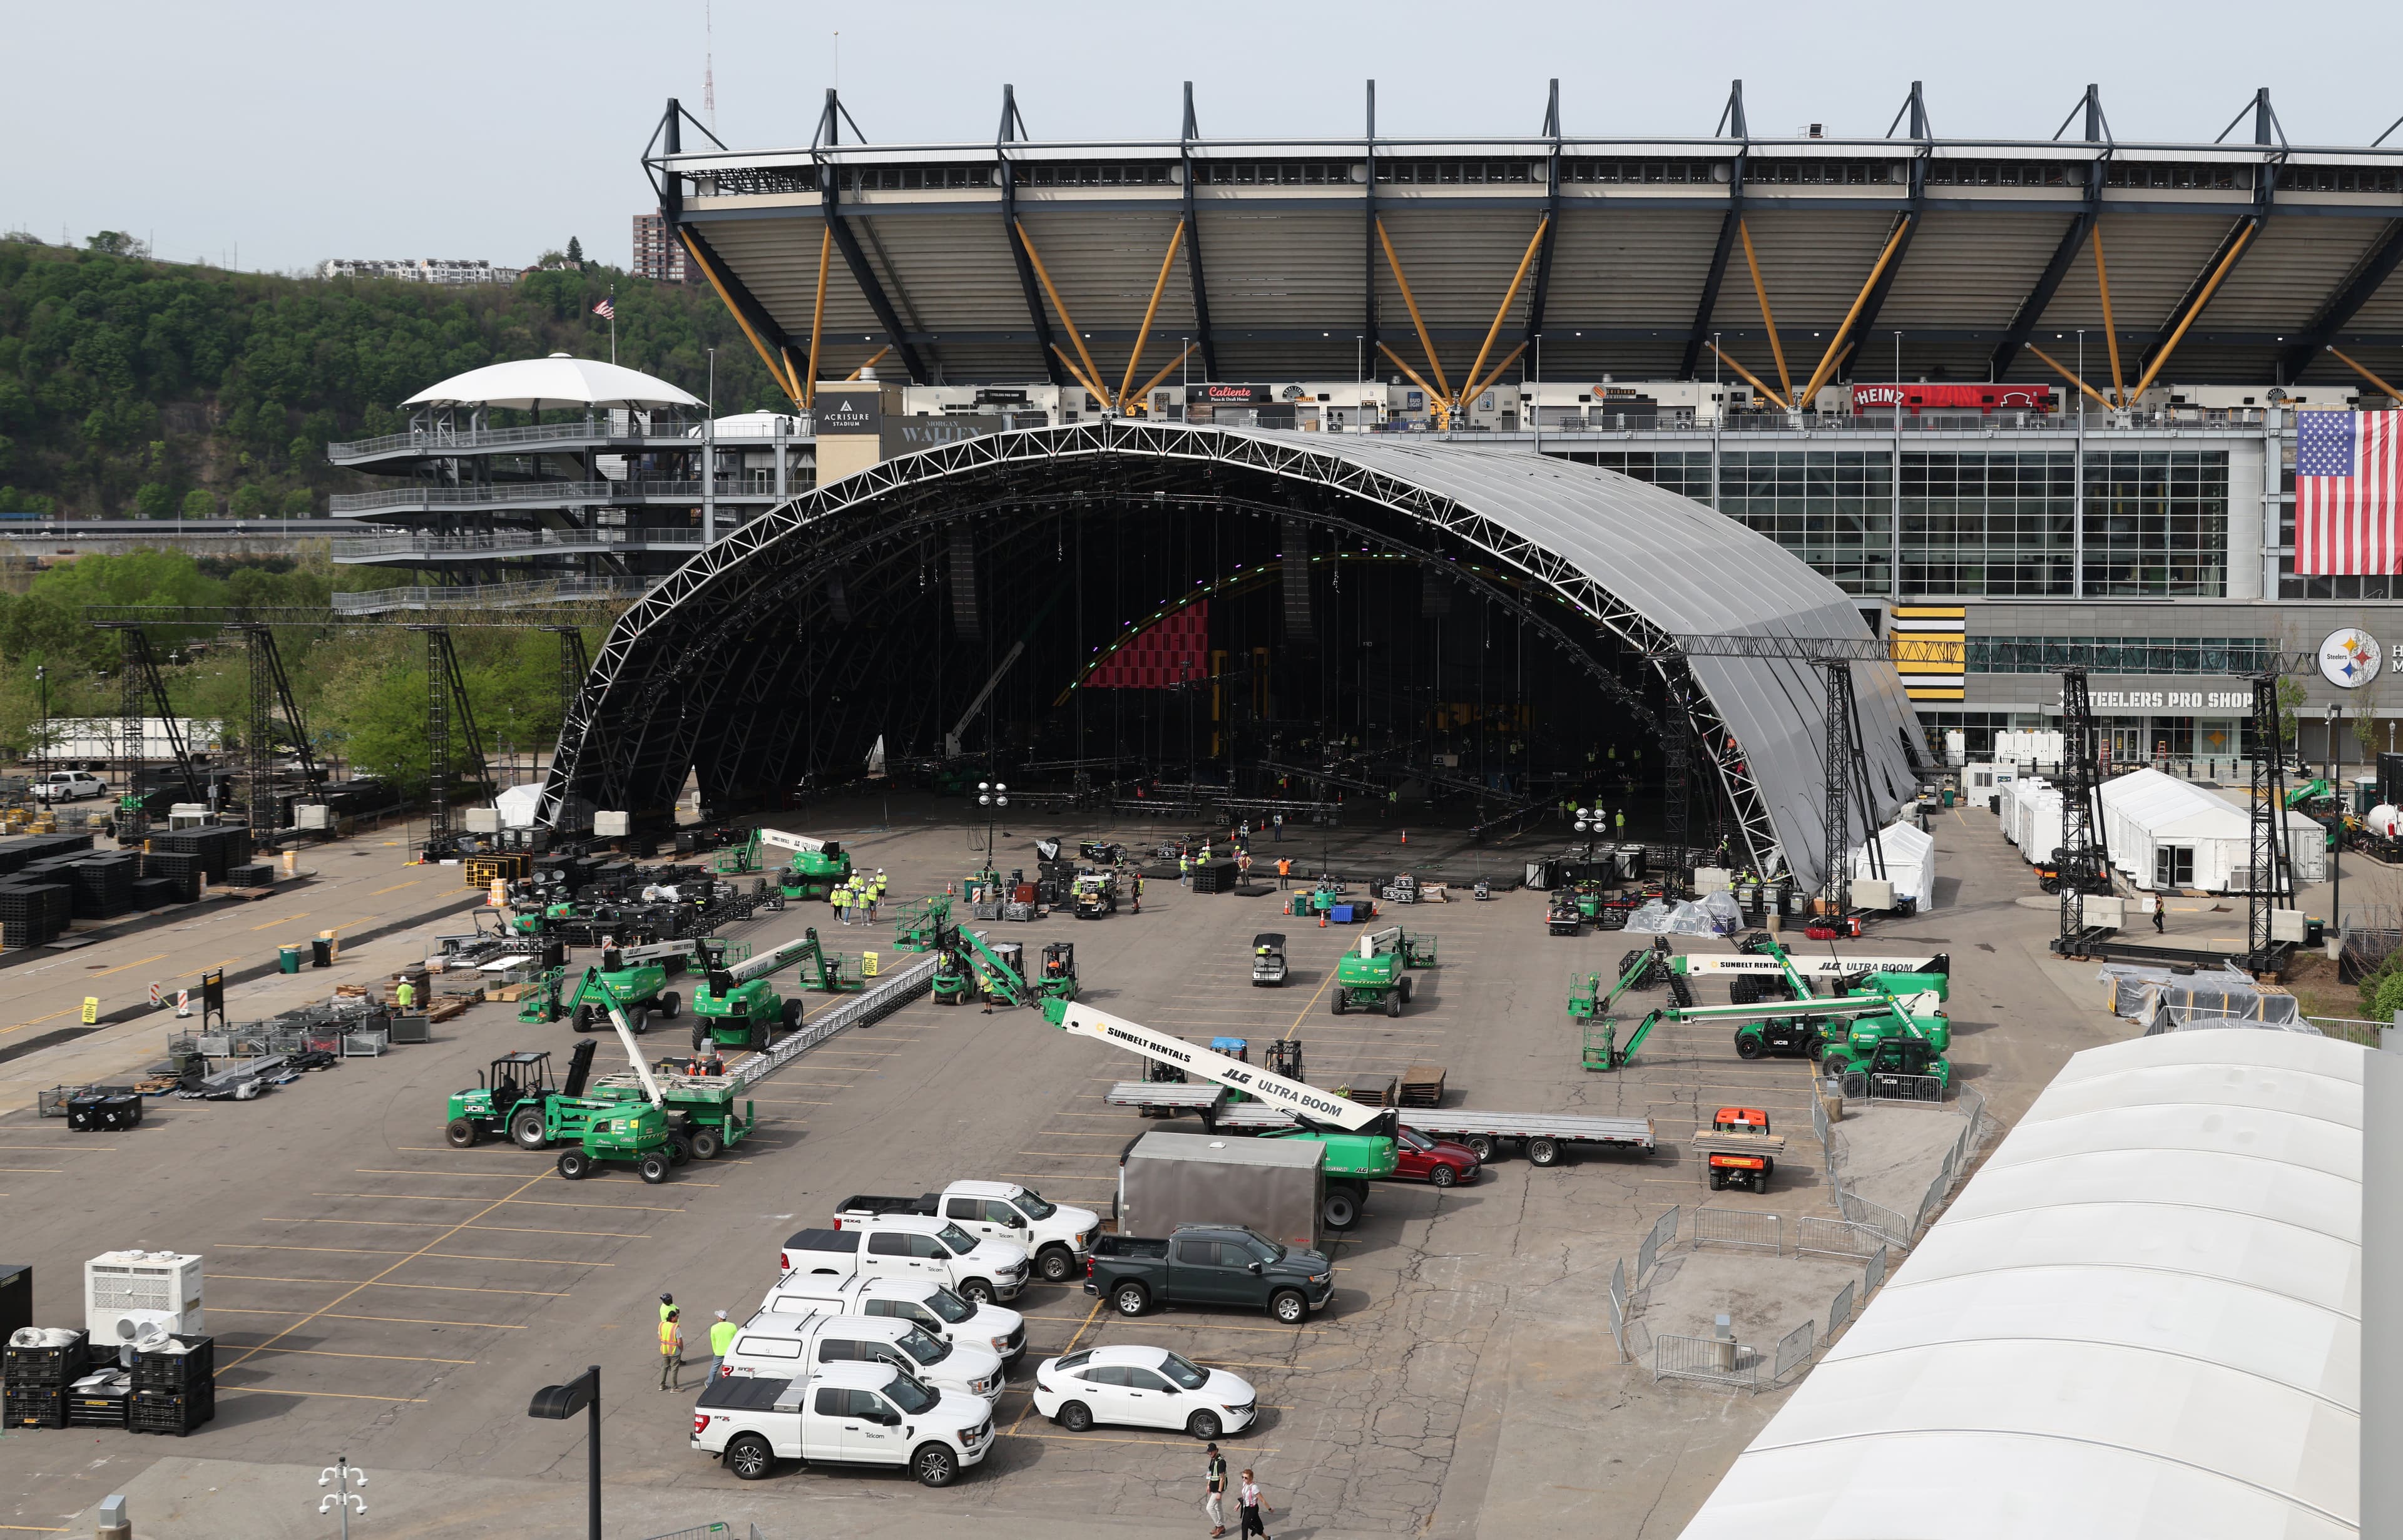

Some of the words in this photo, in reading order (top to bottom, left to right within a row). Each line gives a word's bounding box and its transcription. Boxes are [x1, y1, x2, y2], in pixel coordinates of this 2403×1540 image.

[1209, 386, 1251, 396] Caliente
[1857, 388, 1904, 405] HEINZ
[902, 427, 981, 442] WALLEN
[2168, 692, 2202, 708] PRO
[2208, 692, 2253, 708] SHOP
[745, 967, 756, 977] ULTRA
[756, 961, 767, 972] BOOM
[1846, 962, 1877, 971] ULTRA
[1108, 1027, 1149, 1048] SUNBELT
[1149, 1042, 1191, 1063] RENTALS
[1222, 1068, 1253, 1084] JLG
[1257, 1079, 1299, 1103] ULTRA
[1300, 1095, 1343, 1118] BOOM
